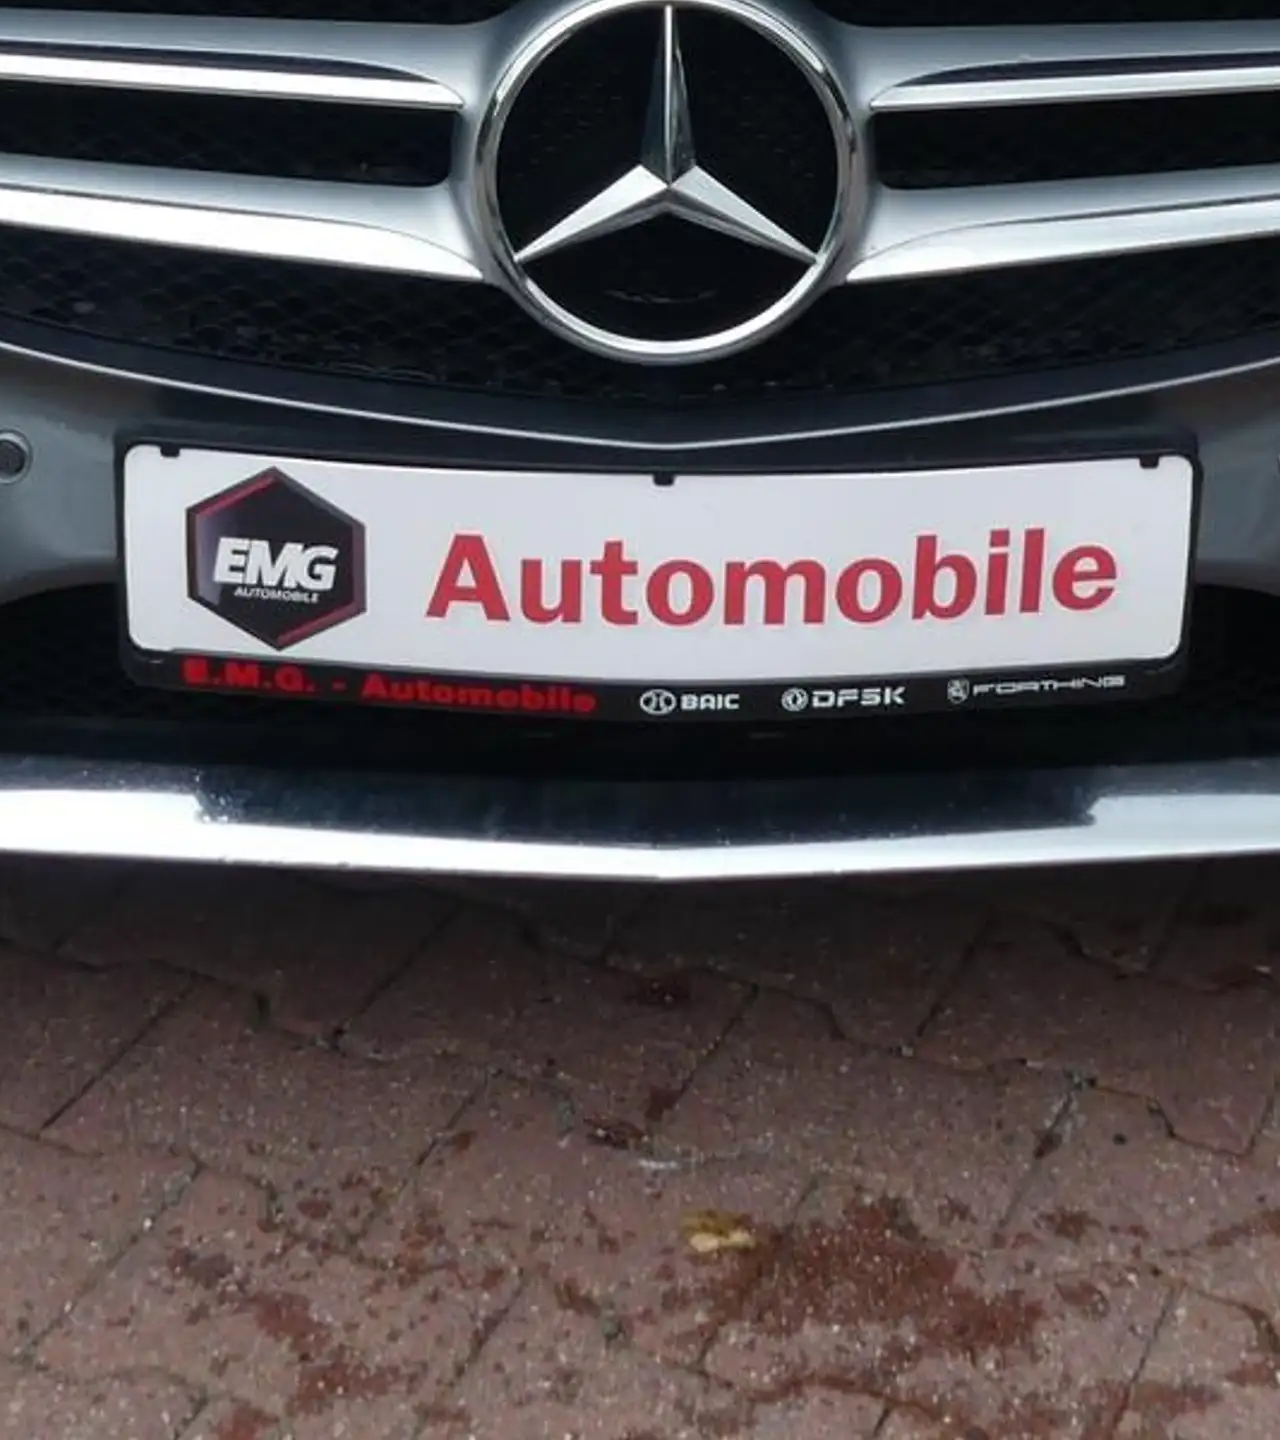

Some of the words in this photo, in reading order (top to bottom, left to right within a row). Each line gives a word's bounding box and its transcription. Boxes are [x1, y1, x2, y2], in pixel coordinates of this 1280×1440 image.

[213, 536, 339, 591] EMG
[424, 528, 1118, 626] Automobile
[234, 585, 320, 604] AUTOMOBILE
[361, 672, 597, 714] Automobile
[972, 675, 1126, 696] FORTHING
[681, 693, 740, 710] BAIC
[812, 686, 906, 708] DFSK
